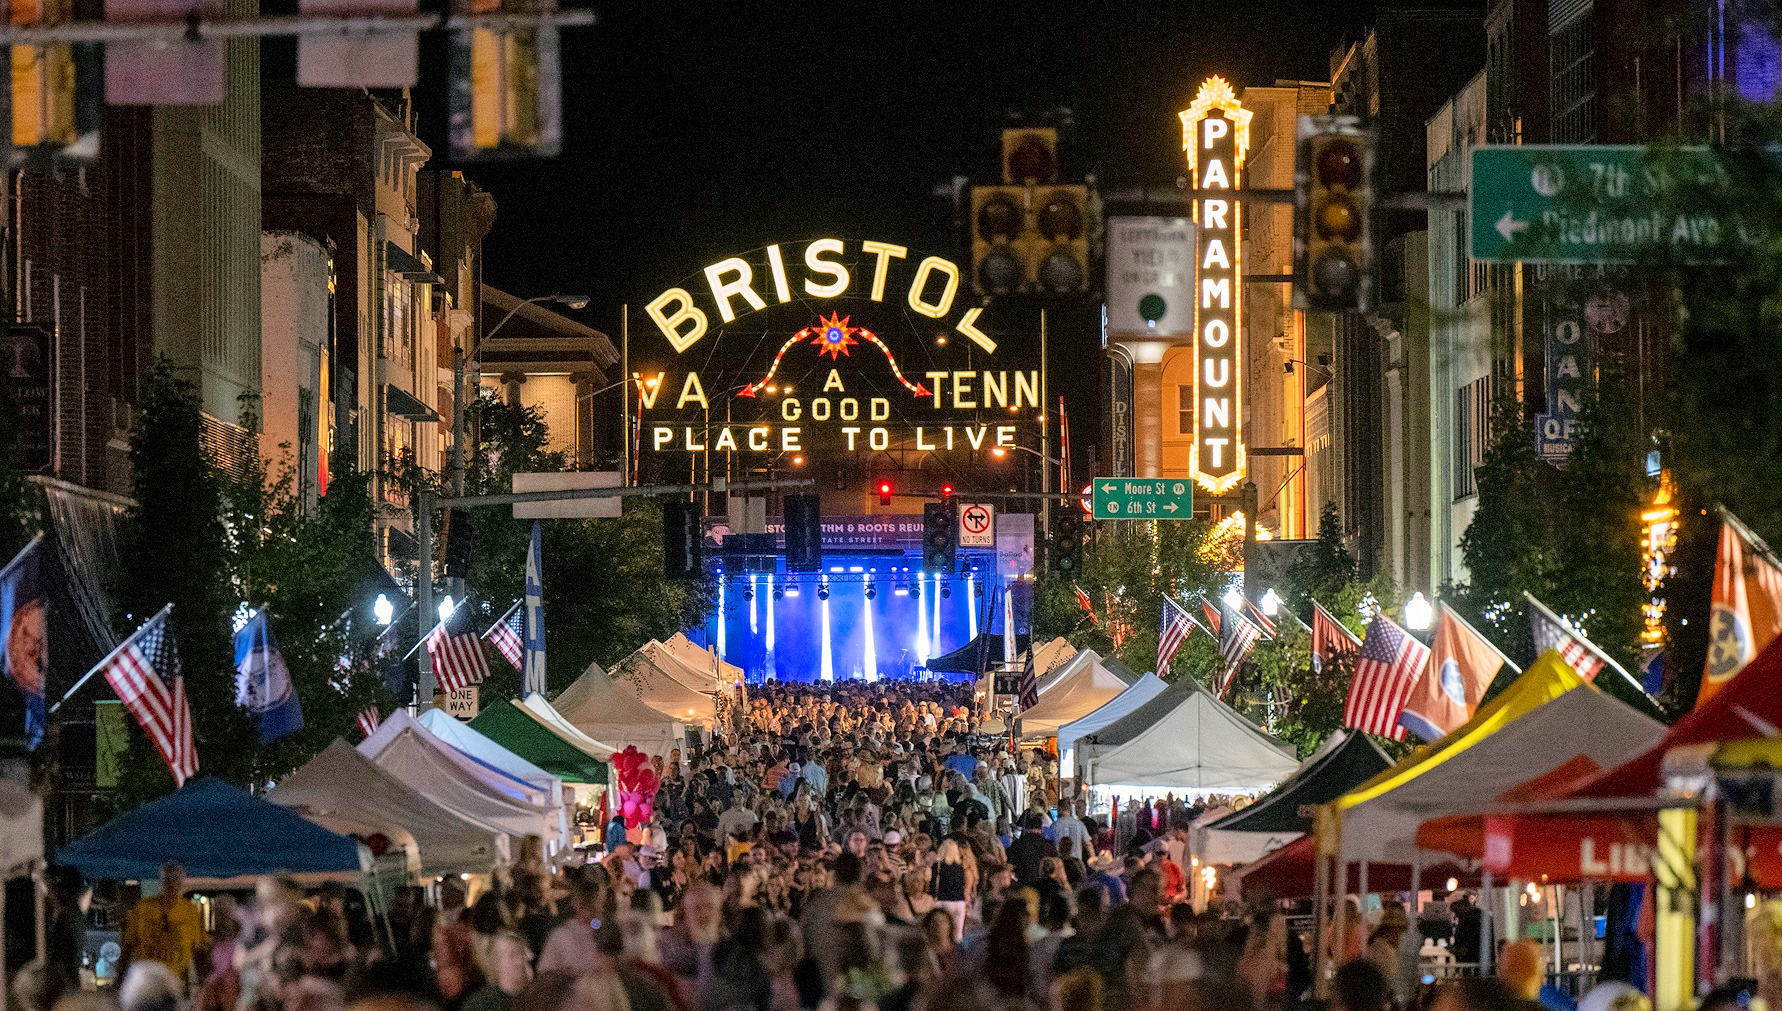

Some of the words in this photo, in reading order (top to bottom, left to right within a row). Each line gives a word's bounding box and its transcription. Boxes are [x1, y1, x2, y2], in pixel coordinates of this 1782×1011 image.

[645, 238, 998, 354] BRISTOL
[1202, 118, 1231, 468] PARAMOUNT
[1556, 319, 1582, 413] OAN
[632, 371, 709, 409] VA
[823, 368, 845, 393] A
[925, 370, 1039, 408] TENN
[781, 397, 890, 421] GOOD
[653, 427, 802, 451] PLACE
[842, 427, 889, 450] TO
[916, 426, 1017, 450] LIVE
[1124, 482, 1152, 495] Moore
[1155, 482, 1165, 495] St
[1127, 501, 1142, 514] 6th
[1146, 501, 1156, 514] St
[820, 524, 844, 533] THM
[847, 523, 855, 533] &
[858, 523, 896, 533] ROOTS
[962, 535, 970, 544] NO
[972, 535, 991, 544] TURNS
[525, 539, 546, 695] ATM
[449, 701, 474, 711] WAY
[450, 689, 473, 700] ONE
